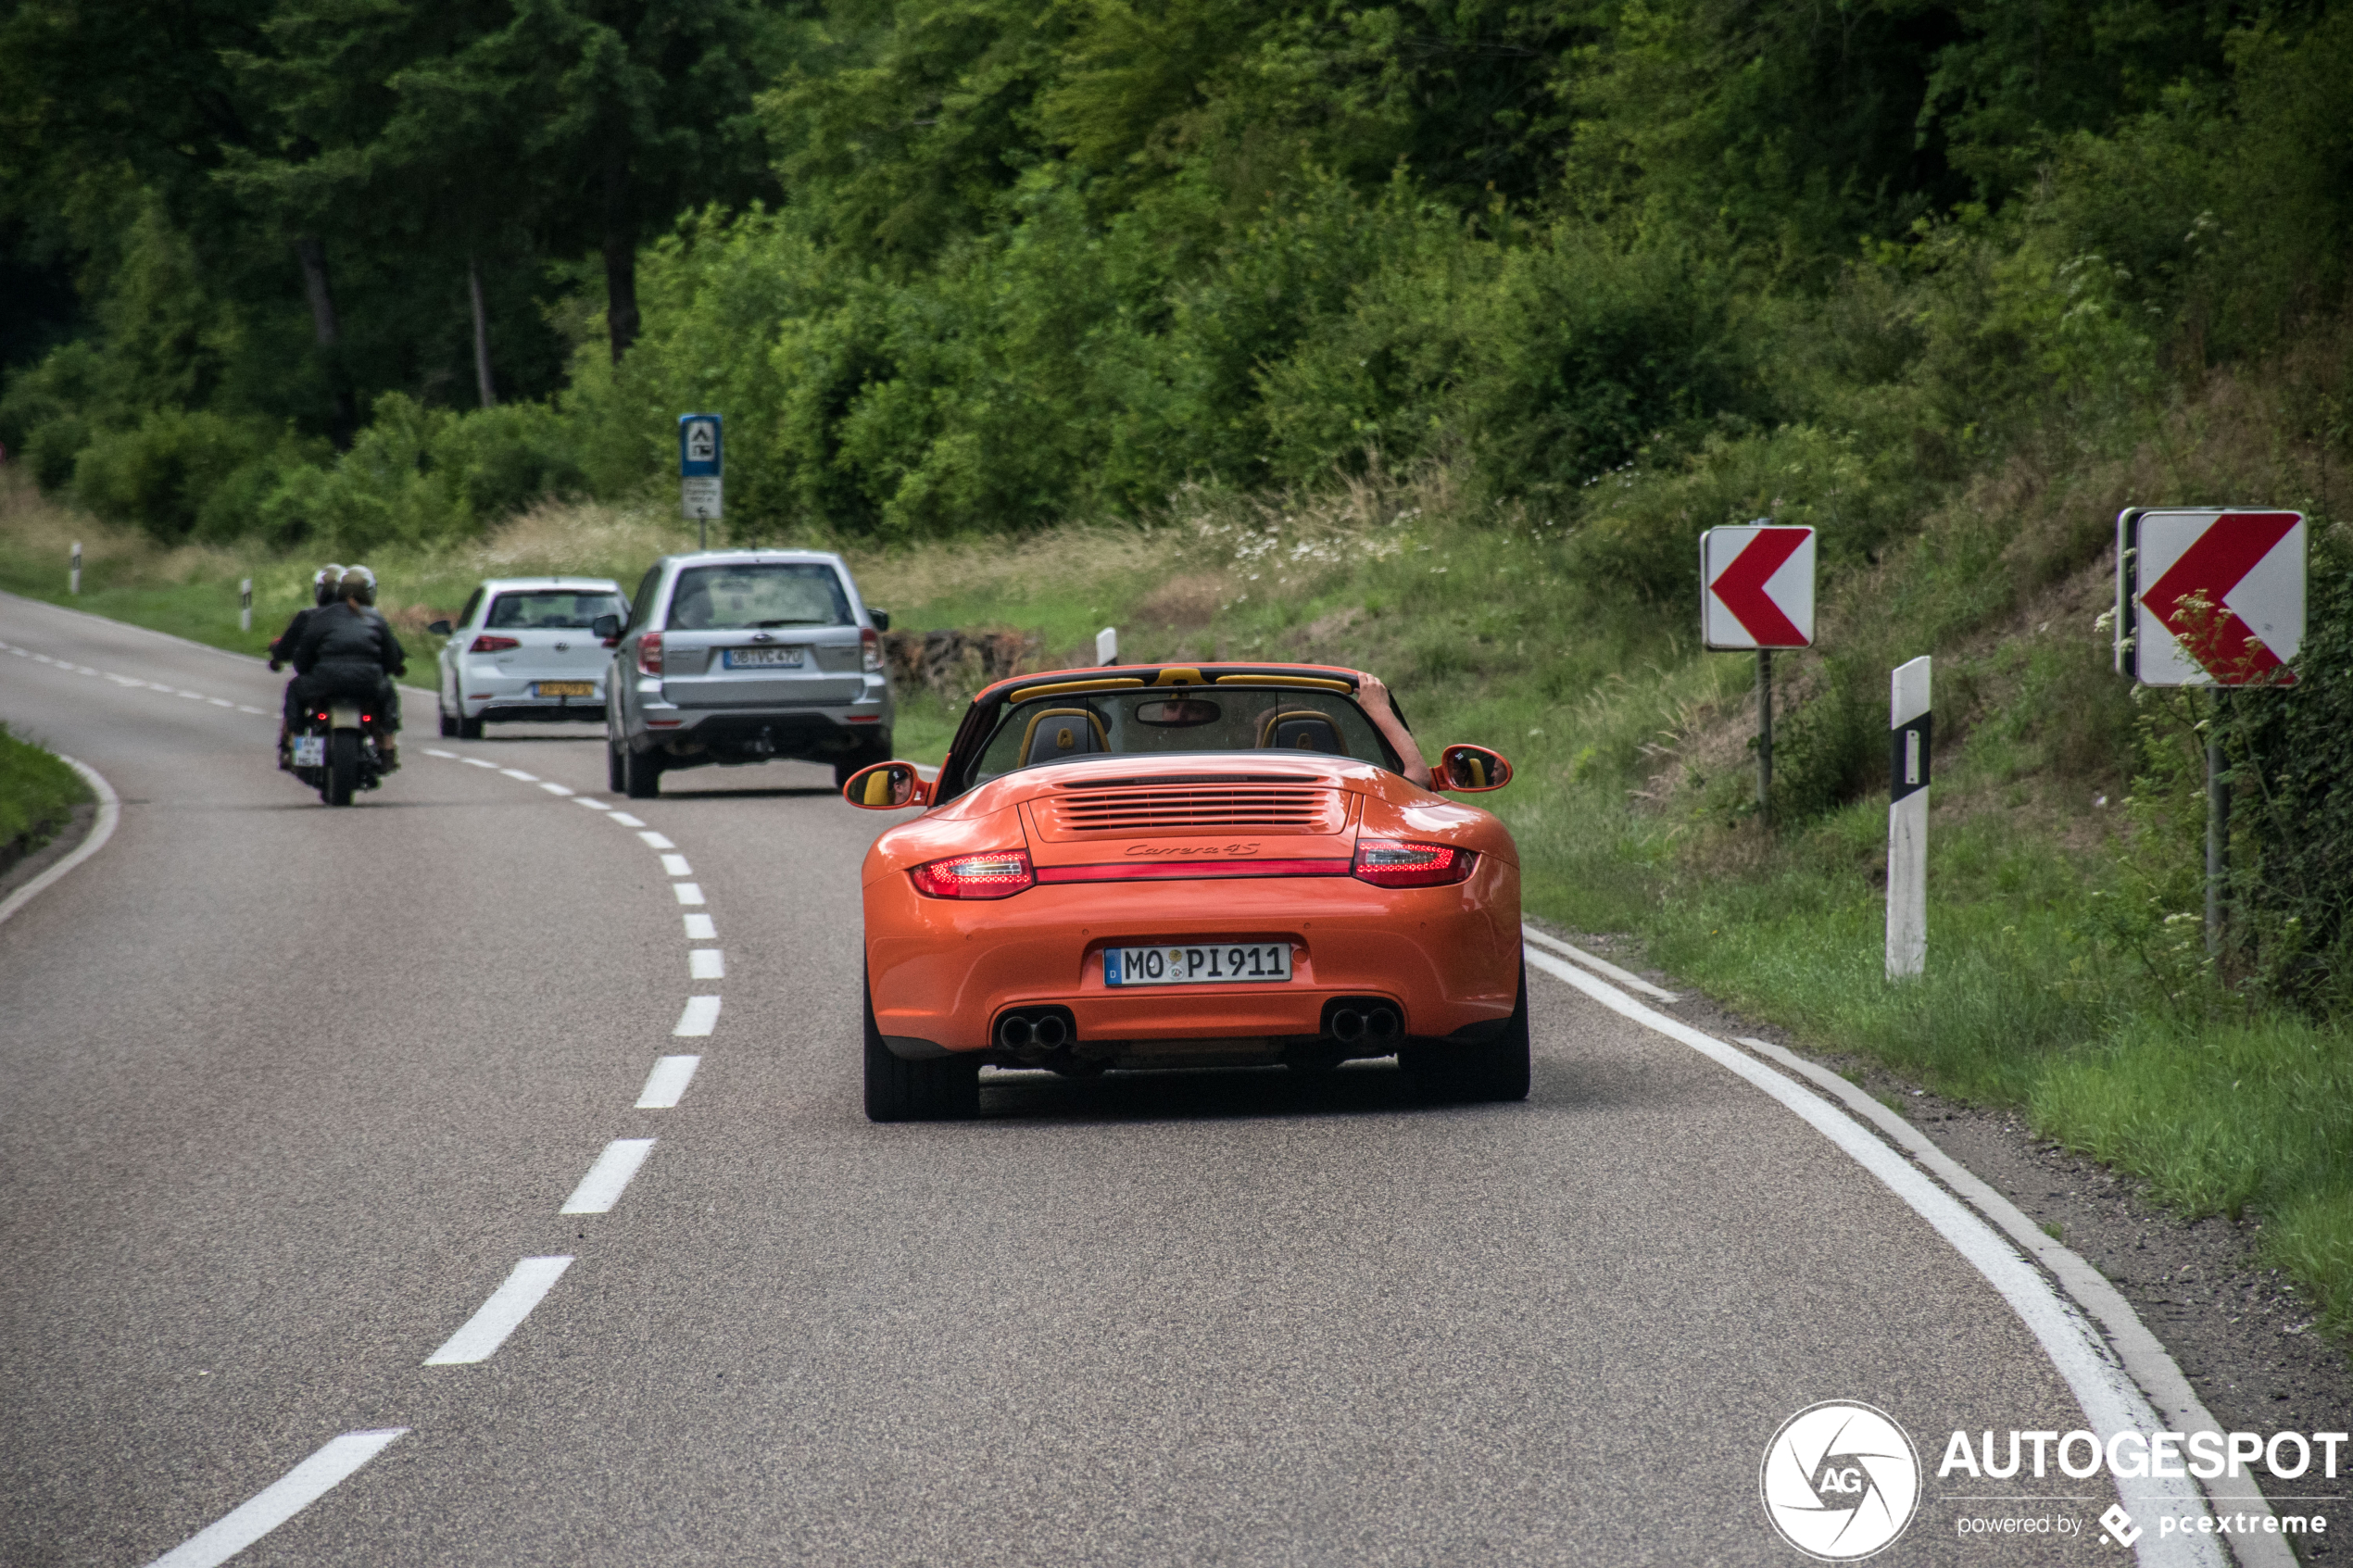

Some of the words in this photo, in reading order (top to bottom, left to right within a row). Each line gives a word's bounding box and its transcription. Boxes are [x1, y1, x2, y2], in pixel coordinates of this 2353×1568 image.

[1124, 844, 1219, 856] Carrera
[1223, 842, 1261, 856] 4S
[1125, 949, 1164, 980] MO
[1110, 970, 1116, 979] D
